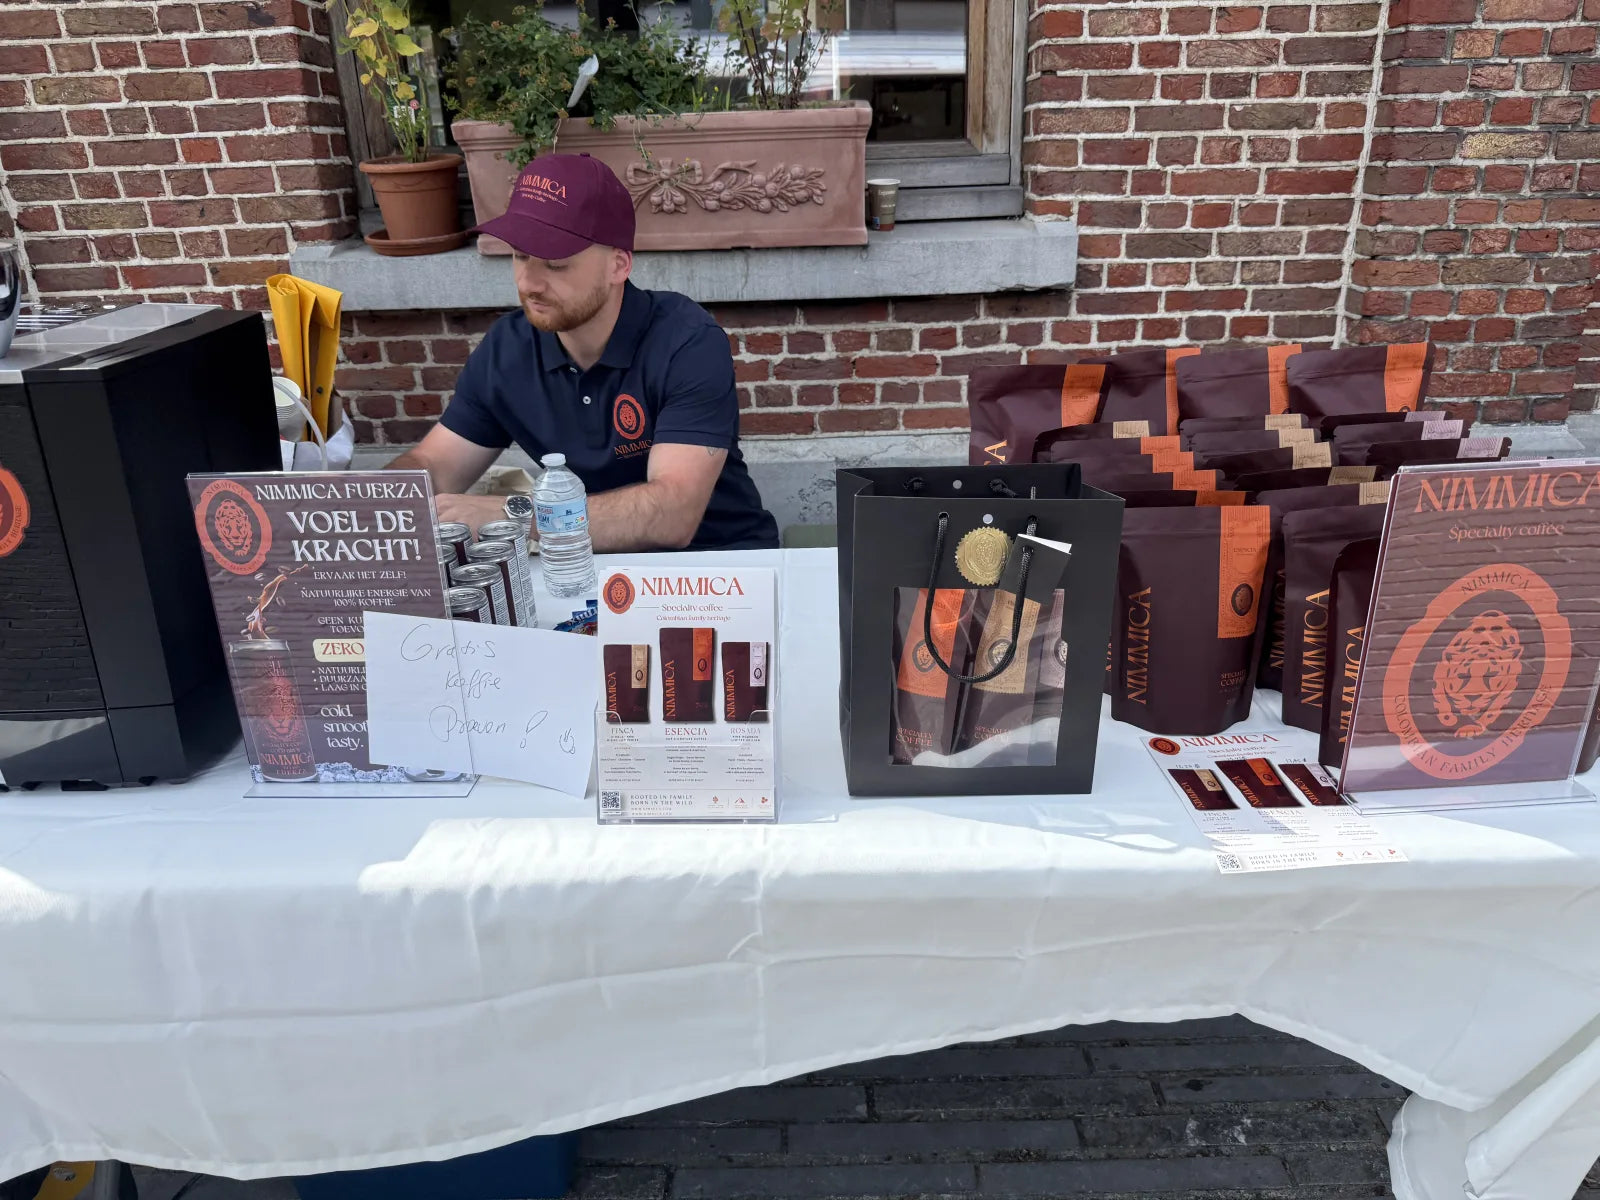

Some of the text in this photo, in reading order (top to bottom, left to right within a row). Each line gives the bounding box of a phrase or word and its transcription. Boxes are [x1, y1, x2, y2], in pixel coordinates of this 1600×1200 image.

[255, 482, 424, 500] NIMMICA FUERZA
[286, 510, 416, 534] VOEL DE
[1448, 521, 1565, 543] Specialty coffee
[291, 538, 422, 562] KRACHT!
[313, 570, 407, 580] ERVAAR HET ZELF!
[1461, 570, 1530, 594] NIMMICA
[301, 588, 431, 598] NATUURLIJKE ENERGIE VAN
[641, 576, 745, 596] NIMMICA
[333, 598, 357, 607] 100%
[661, 603, 724, 612] Specialty coffee
[317, 616, 344, 625] GEEN
[320, 642, 365, 656] ZERO
[401, 623, 496, 662] Gratis
[1127, 586, 1151, 705] NIMMICA
[1301, 587, 1330, 708] NIMMICA
[321, 684, 349, 692] LAAG
[664, 659, 676, 718] NIMMICA
[726, 669, 736, 719] NIMMICA
[664, 727, 708, 736] ESENCIA
[1394, 683, 1553, 774] COLOMBIAN FAMILY HERITAGE
[326, 736, 364, 751] tasty.
[1180, 734, 1280, 747] NIMMICA
